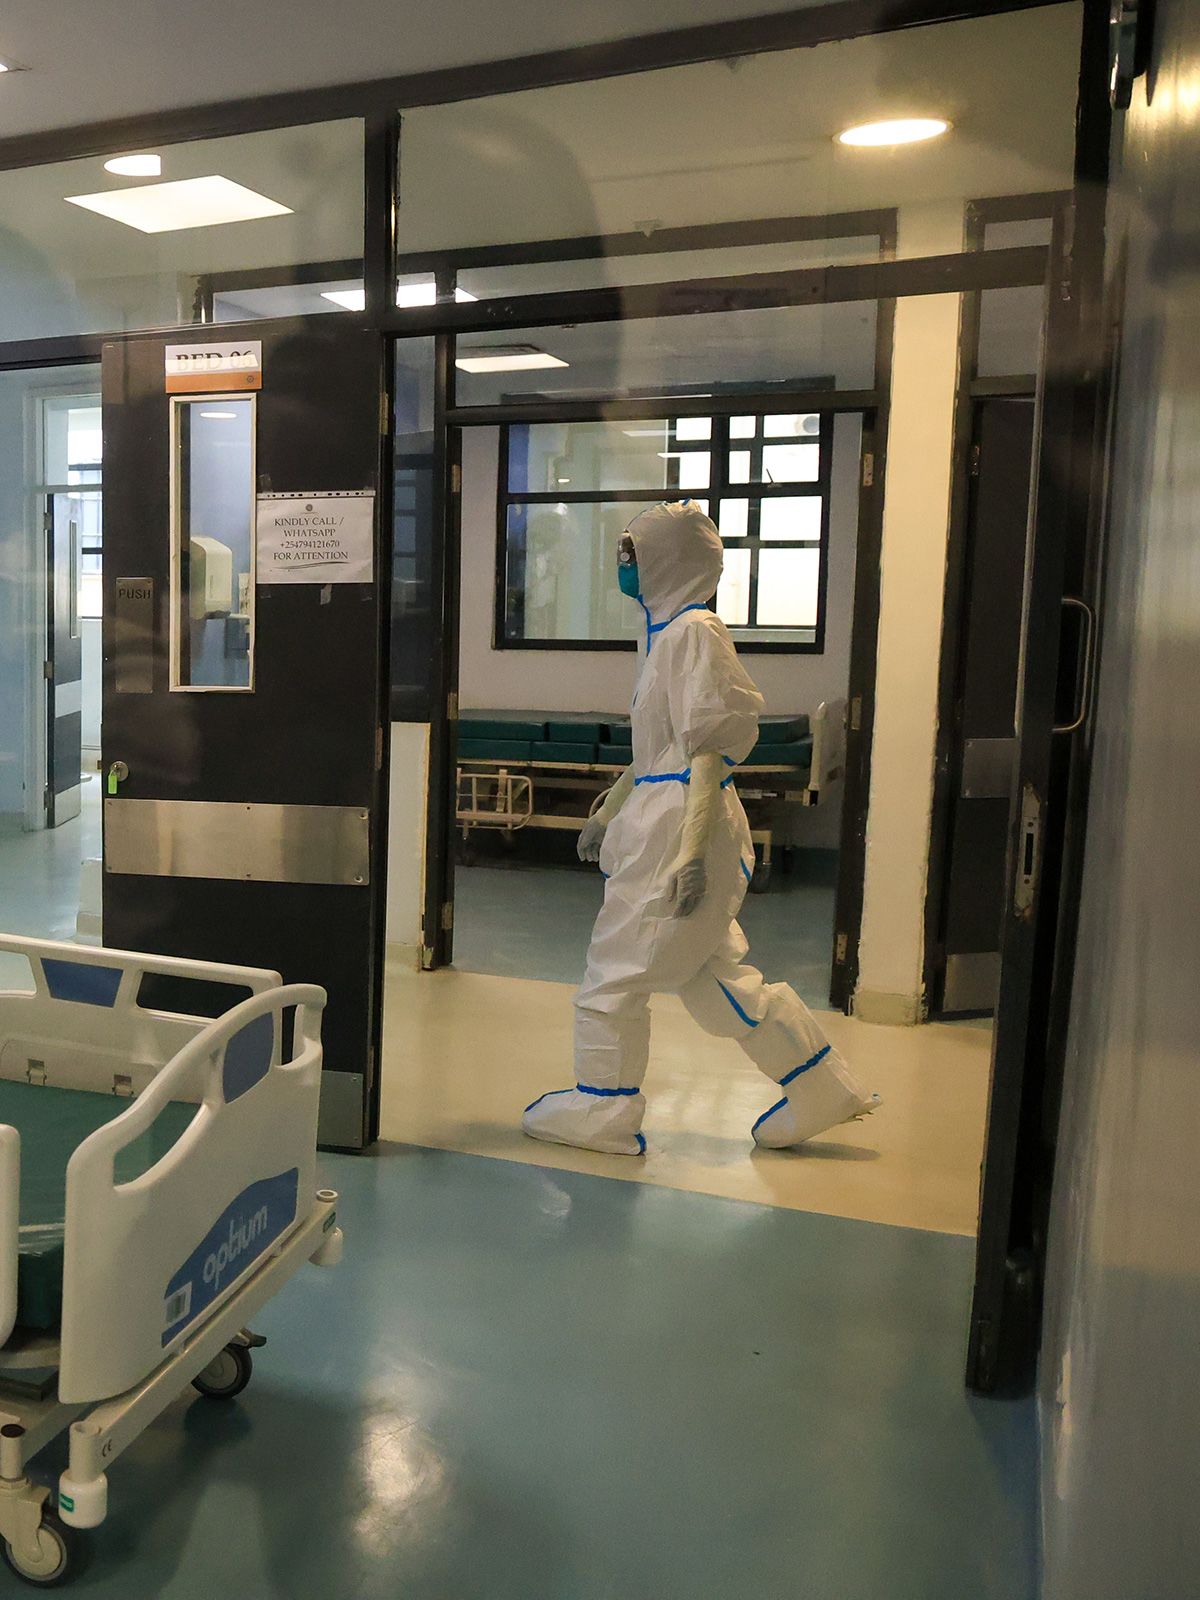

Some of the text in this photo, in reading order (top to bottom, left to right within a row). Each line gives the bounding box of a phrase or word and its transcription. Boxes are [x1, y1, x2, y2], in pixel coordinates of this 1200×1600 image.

[274, 516, 345, 526] KINDLY CALL /
[283, 528, 336, 537] WHATSAPP
[280, 540, 340, 548] +254794121670
[273, 551, 348, 561] FOR ATTENTION
[118, 588, 151, 599] PUSH
